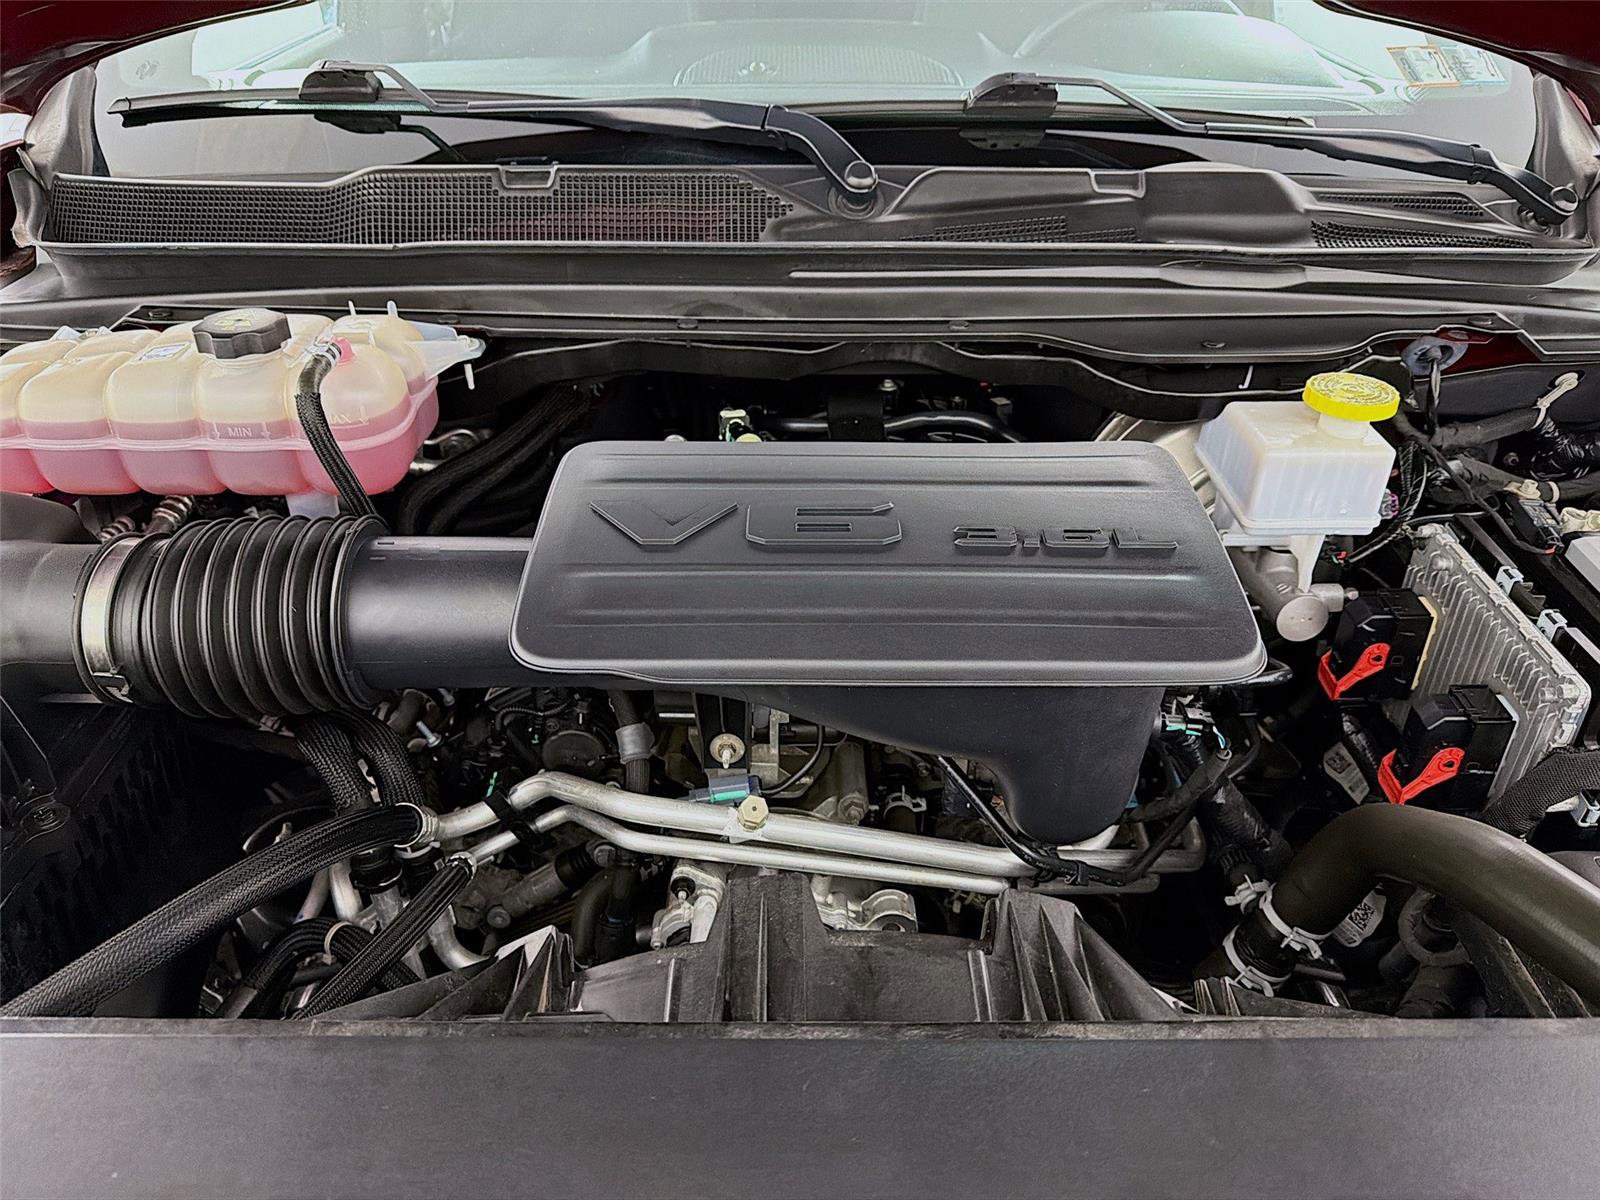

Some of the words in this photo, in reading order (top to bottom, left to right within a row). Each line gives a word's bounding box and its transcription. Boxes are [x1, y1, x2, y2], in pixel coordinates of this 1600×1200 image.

[329, 413, 352, 425] AX
[227, 427, 252, 438] MIN
[588, 499, 903, 546] V6
[953, 526, 1179, 550] 3.6L
